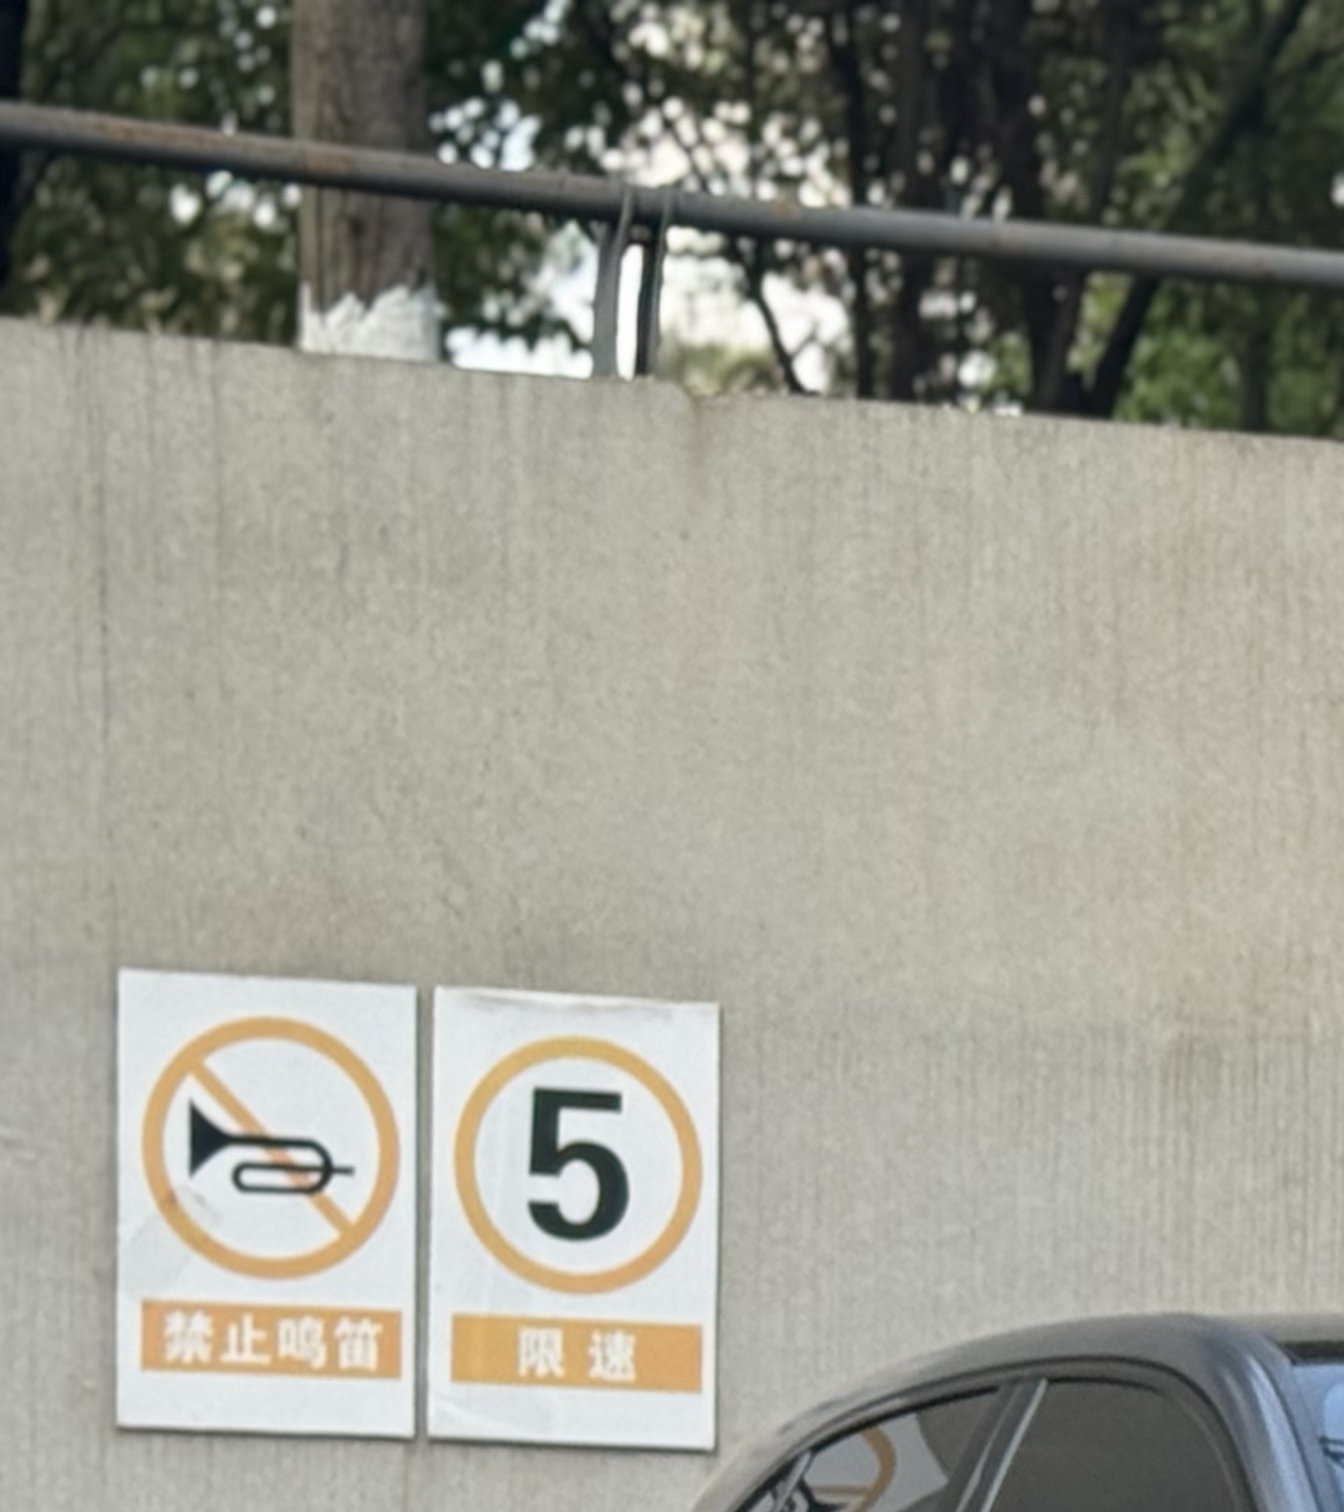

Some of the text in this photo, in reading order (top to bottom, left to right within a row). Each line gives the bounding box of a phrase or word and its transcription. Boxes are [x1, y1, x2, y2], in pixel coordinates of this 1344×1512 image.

[527, 1086, 630, 1241] 5
[164, 1309, 383, 1371] 禁止鸣笛
[517, 1326, 636, 1382] 限速
